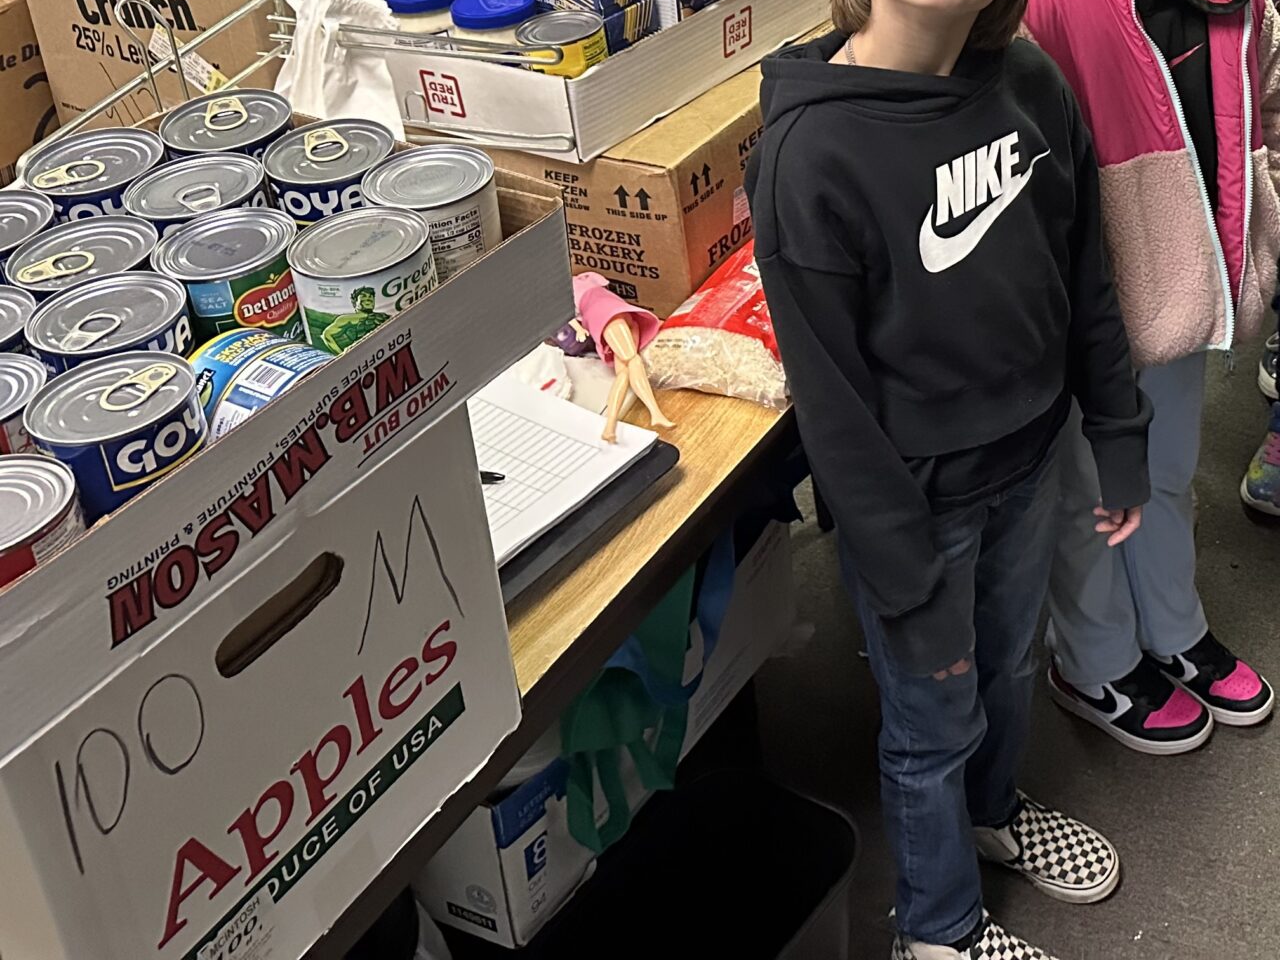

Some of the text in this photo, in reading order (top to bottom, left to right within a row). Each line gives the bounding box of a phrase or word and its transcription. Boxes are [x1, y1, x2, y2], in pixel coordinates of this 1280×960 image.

[727, 15, 749, 35] RED
[727, 26, 749, 48] TRU
[71, 23, 115, 58] 25%
[428, 81, 455, 95] RED
[432, 92, 458, 107] TRU
[544, 169, 580, 184] KEEP
[934, 129, 1024, 227] NIKE
[683, 178, 725, 215] THIS SIDE UP
[455, 209, 477, 223] Facts
[606, 207, 668, 222] THIS SIDE UP
[467, 229, 481, 242] 50
[567, 223, 641, 246] FROZEN
[569, 239, 645, 263] BAKERY
[382, 252, 433, 298] Green
[570, 253, 660, 279] RODUCTS
[201, 302, 227, 310] SALT
[241, 297, 267, 318] Del
[266, 300, 293, 320] Quality
[388, 328, 412, 352] FOR
[341, 348, 386, 387] OFFICE
[273, 384, 340, 450] SUPPLIES,
[362, 372, 451, 456] WHO BUT
[104, 339, 424, 650] W.B.MASON
[196, 445, 275, 527] FURNITURE
[183, 523, 194, 536] &
[107, 535, 181, 591] PRINTING
[54, 673, 204, 875] 100
[348, 714, 443, 815] OF USA
[158, 619, 458, 951] Apples
[208, 896, 261, 959] MCINTOSH
